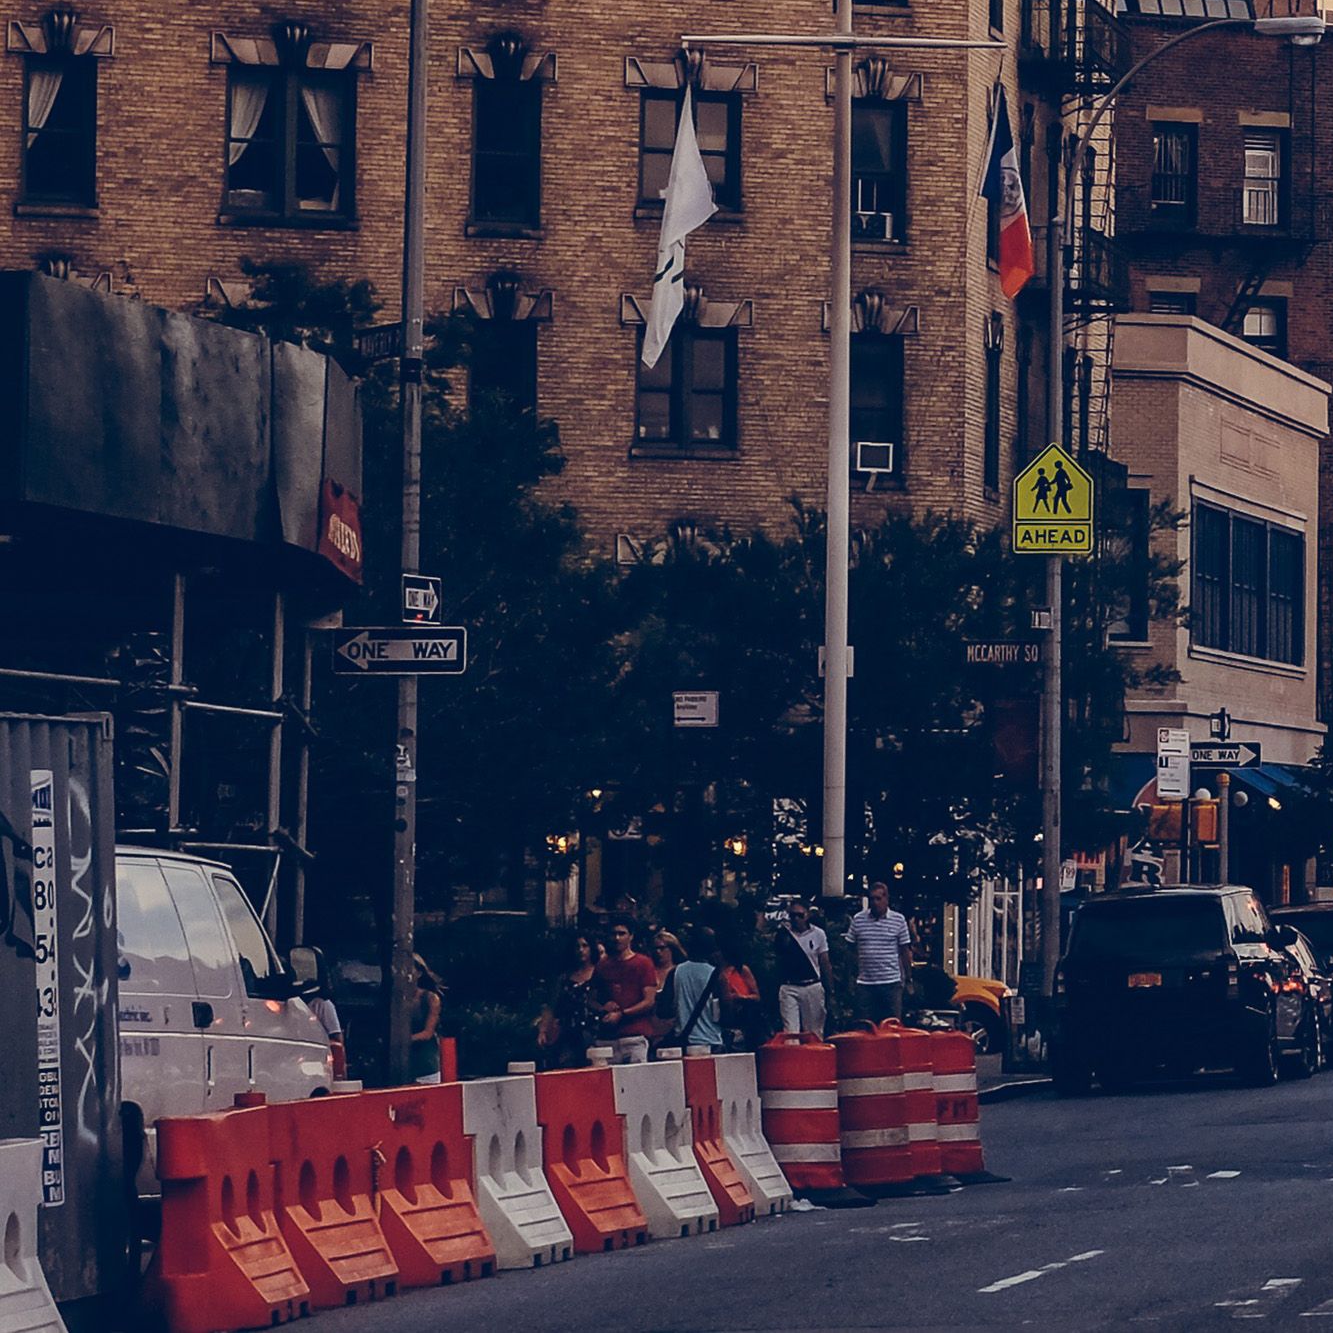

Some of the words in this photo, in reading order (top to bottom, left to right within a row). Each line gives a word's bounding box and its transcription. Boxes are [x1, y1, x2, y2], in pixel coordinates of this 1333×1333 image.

[1020, 529, 1086, 544] AHEAD
[347, 641, 390, 659] ONE
[412, 641, 454, 659] WAY
[966, 644, 1020, 664] MCCARTHY
[1192, 750, 1213, 761] ONE
[1218, 750, 1240, 760] WAY
